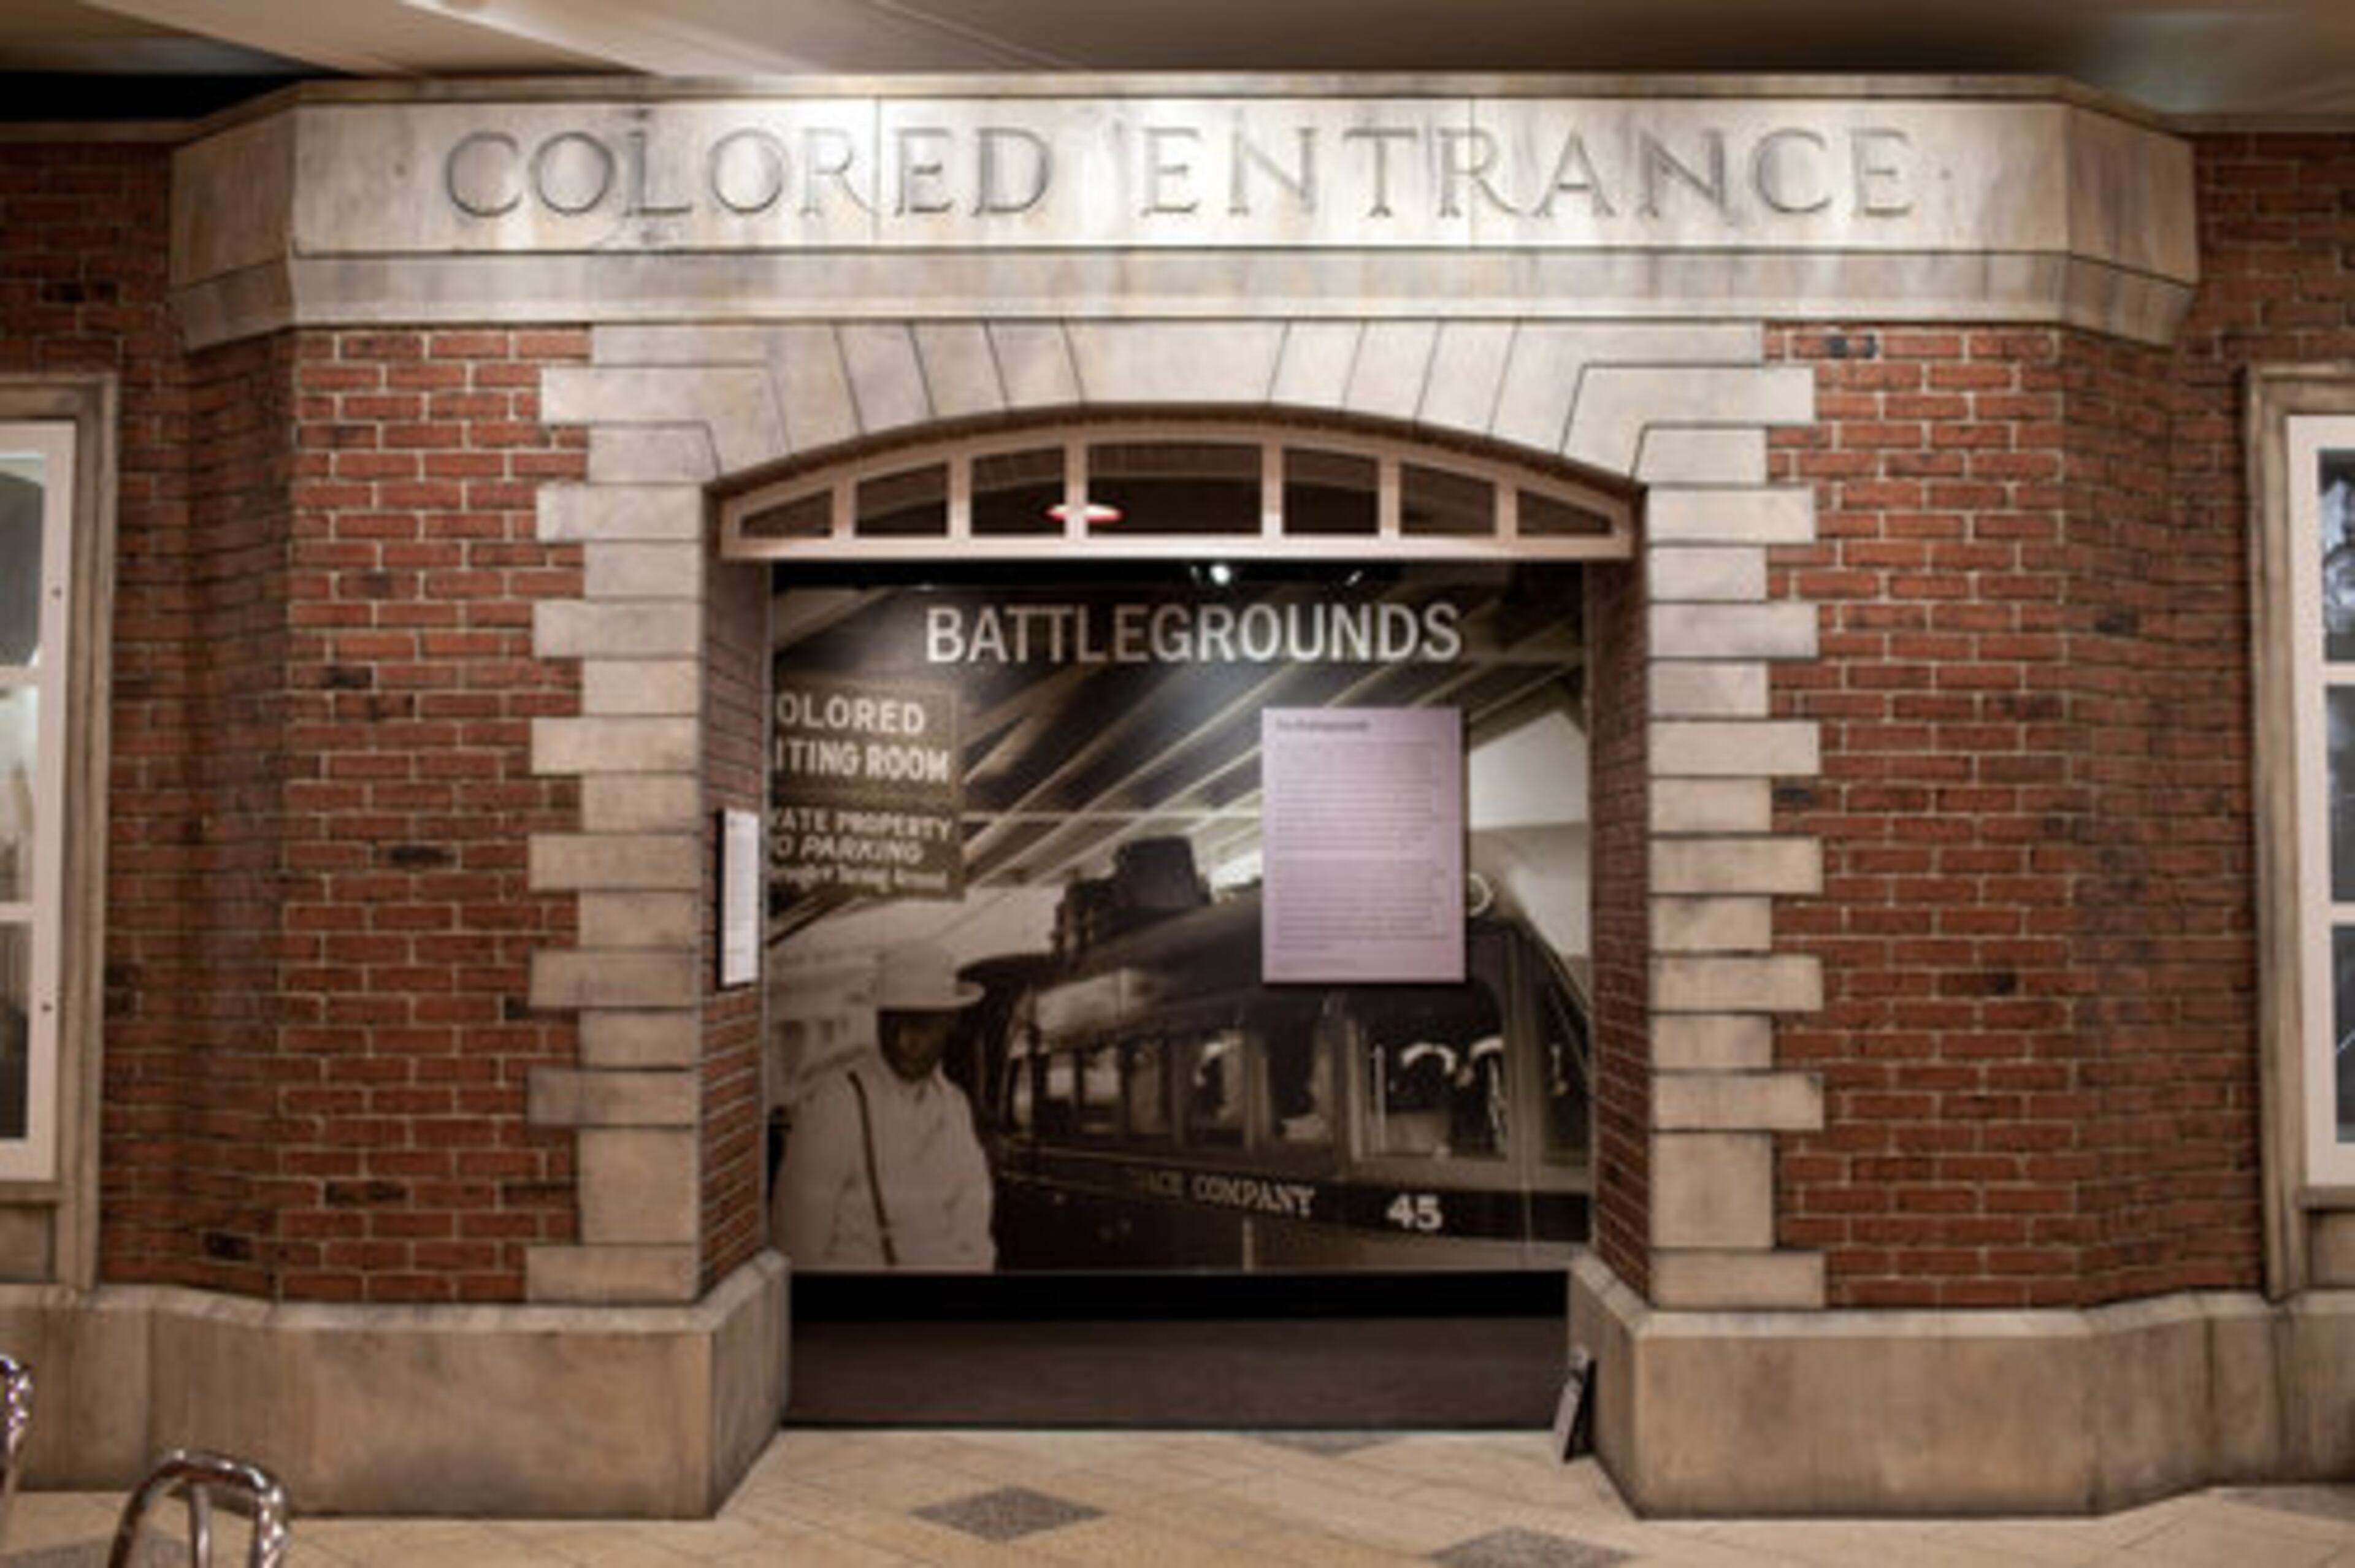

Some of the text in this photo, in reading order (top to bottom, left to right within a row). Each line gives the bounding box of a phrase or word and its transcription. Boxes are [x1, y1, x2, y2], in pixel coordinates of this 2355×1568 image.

[443, 126, 1914, 217] COLORED ENTRANCE
[925, 602, 1461, 664] BATTLEGROUNDS
[866, 744, 950, 784] ROOM
[836, 811, 952, 841] PROPERTY
[800, 835, 925, 865] PARKING
[1192, 1172, 1316, 1218] COMPANY
[1386, 1193, 1444, 1231] 45
